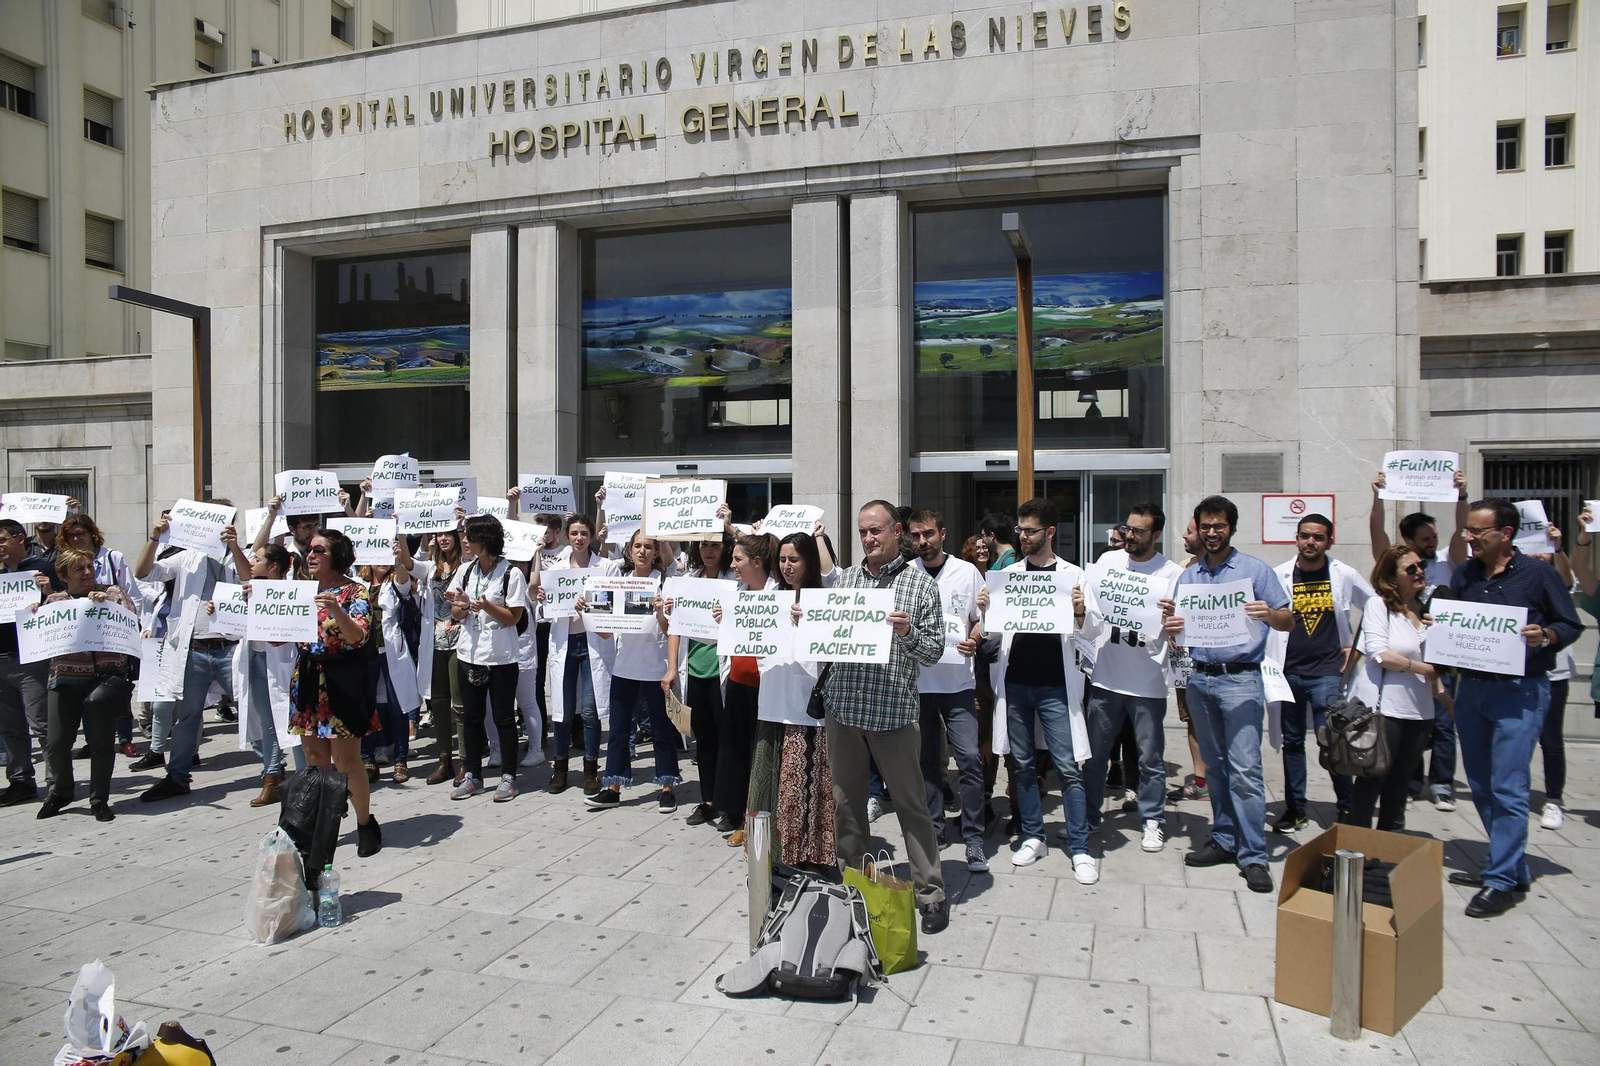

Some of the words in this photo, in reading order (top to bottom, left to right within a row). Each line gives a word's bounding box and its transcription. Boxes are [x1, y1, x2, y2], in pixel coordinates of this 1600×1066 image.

[284, 95, 415, 137] HOSPITAL
[430, 57, 672, 117] UNIVERSITARIO
[690, 38, 817, 79] VIRGEN
[838, 31, 878, 63] DE
[899, 20, 967, 55] LAS
[988, 2, 1131, 47] NIEVES
[488, 113, 656, 157] HOSPITAL
[680, 89, 859, 133] GENERAL
[383, 460, 400, 469] Por
[401, 461, 408, 470] el
[1387, 458, 1455, 472] #FuiMIR
[292, 477, 311, 486] Por
[314, 476, 323, 485] ti
[373, 471, 417, 481] PACIENTE
[550, 477, 556, 485] la
[523, 486, 569, 494] SEGURIDAD
[608, 482, 646, 490] SEGURIDA
[670, 486, 688, 494] Por
[692, 484, 701, 493] la
[280, 492, 287, 502] y
[292, 491, 311, 502] por
[315, 488, 338, 497] MIR
[399, 498, 454, 508] SEGURIDAD
[653, 495, 718, 507] SEGURIDAD
[529, 503, 568, 511] PACIENTE
[678, 507, 693, 517] del
[176, 507, 227, 525] #SeréMIR
[420, 509, 433, 518] del
[608, 514, 642, 523] ¡Formac
[779, 510, 795, 518] Por
[797, 510, 806, 518] el
[185, 523, 201, 531] apoyo
[404, 520, 451, 529] PACIENTE
[658, 518, 713, 530] PACIENTE
[765, 520, 812, 529] PACIENTE
[184, 528, 207, 539] HUELGA
[344, 525, 364, 535] Por
[368, 525, 378, 534] ti
[351, 540, 362, 548] or
[366, 538, 390, 548] MIR
[1009, 573, 1028, 582] Por
[1032, 574, 1052, 582] una
[1107, 569, 1126, 578] Por
[1128, 574, 1148, 584] una
[0, 579, 36, 594] iMIR
[558, 577, 578, 587] Por
[1004, 585, 1056, 594] SANIDAD
[1100, 580, 1150, 595] SANIDAD
[232, 591, 243, 601] Po
[266, 588, 285, 600] Por
[288, 587, 298, 600] el
[547, 594, 554, 604] y
[558, 591, 578, 604] por
[739, 592, 756, 602] Por
[827, 593, 850, 605] Por
[854, 591, 866, 605] la
[1006, 595, 1055, 607] PÚBLICA
[1100, 591, 1146, 608] PÚBLICA
[1180, 591, 1248, 610] #FuiMIR
[219, 602, 248, 615] PACIE
[255, 603, 310, 616] PACIENTE
[734, 605, 779, 615] SANIDAD
[1113, 606, 1129, 616] DE
[23, 608, 77, 630] #FuiMI
[84, 606, 138, 633] #FuiMIR
[807, 608, 886, 622] SEGURIDAD
[1022, 610, 1038, 619] DE
[736, 616, 778, 628] PÚBLICA
[1004, 621, 1054, 631] CALIDAD
[1102, 614, 1143, 630] ALIDAD
[1198, 622, 1230, 630] HUELGA
[1435, 611, 1518, 635] #FuiMIR
[44, 627, 61, 636] apoyo
[104, 624, 122, 632] apoyo
[833, 625, 853, 638] del
[44, 632, 73, 643] HUELGA
[102, 631, 129, 641] HUELGA
[749, 632, 762, 641] DE
[1456, 633, 1480, 642] apoyo
[734, 644, 778, 655] CALIDAD
[810, 642, 877, 656] PACIENTE
[1456, 642, 1492, 652] HUELGA
